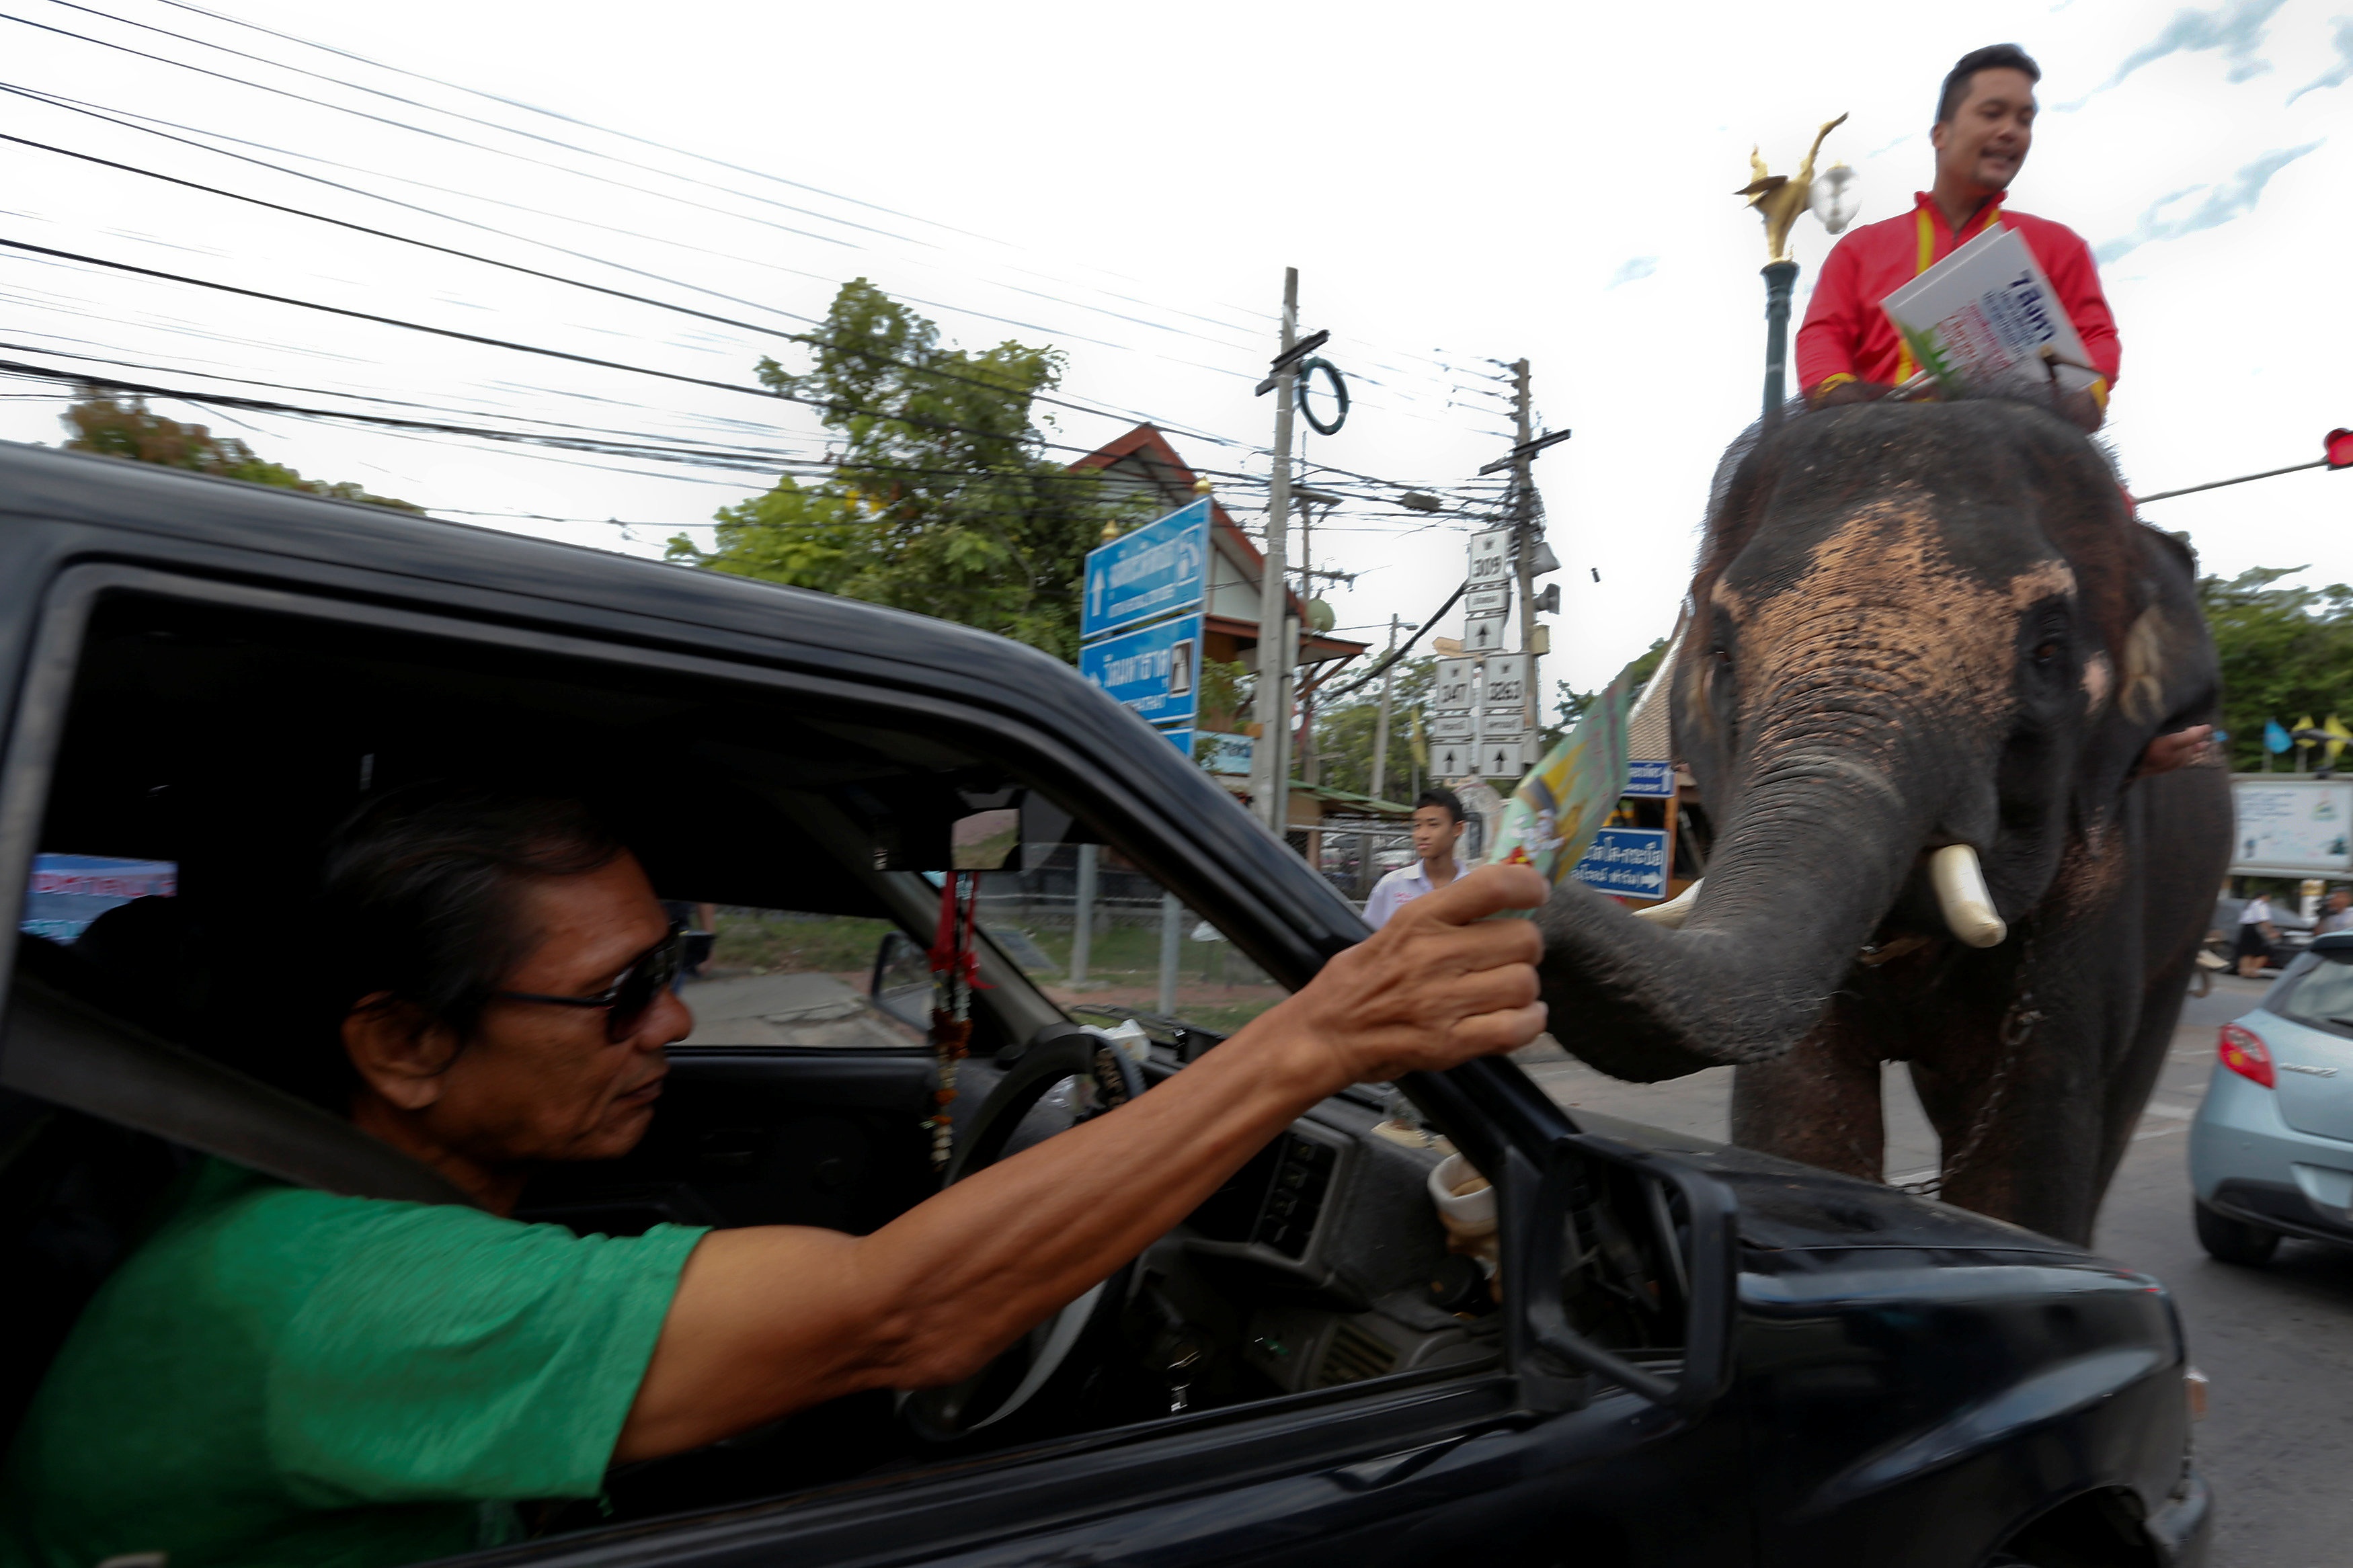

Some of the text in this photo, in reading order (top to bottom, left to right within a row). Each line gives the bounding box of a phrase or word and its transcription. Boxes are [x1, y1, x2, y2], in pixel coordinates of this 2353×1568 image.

[1472, 554, 1503, 578] 309
[1441, 682, 1468, 703] 347
[1488, 679, 1522, 701] 3263
